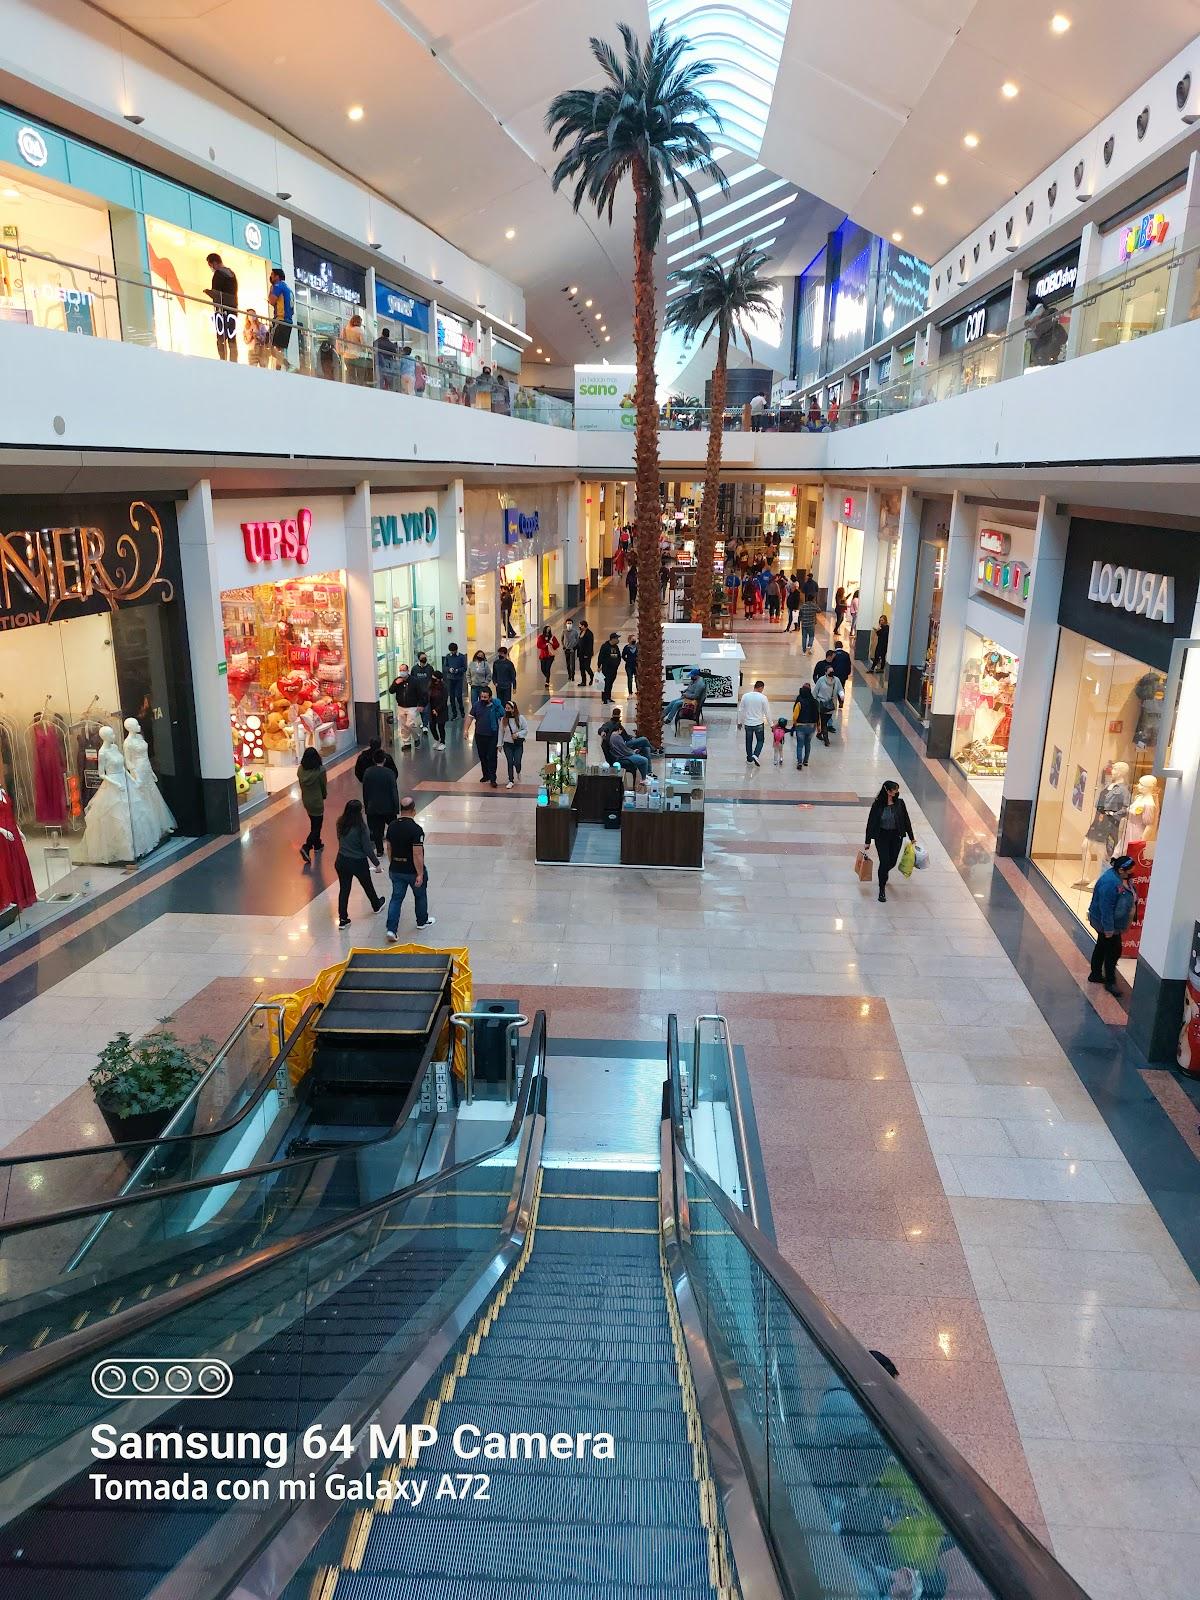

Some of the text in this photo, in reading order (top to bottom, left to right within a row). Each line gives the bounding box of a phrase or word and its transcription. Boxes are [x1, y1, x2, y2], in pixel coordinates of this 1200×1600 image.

[579, 384, 618, 396] sano
[240, 508, 312, 565] UPS!
[1088, 560, 1175, 624] LOCURA
